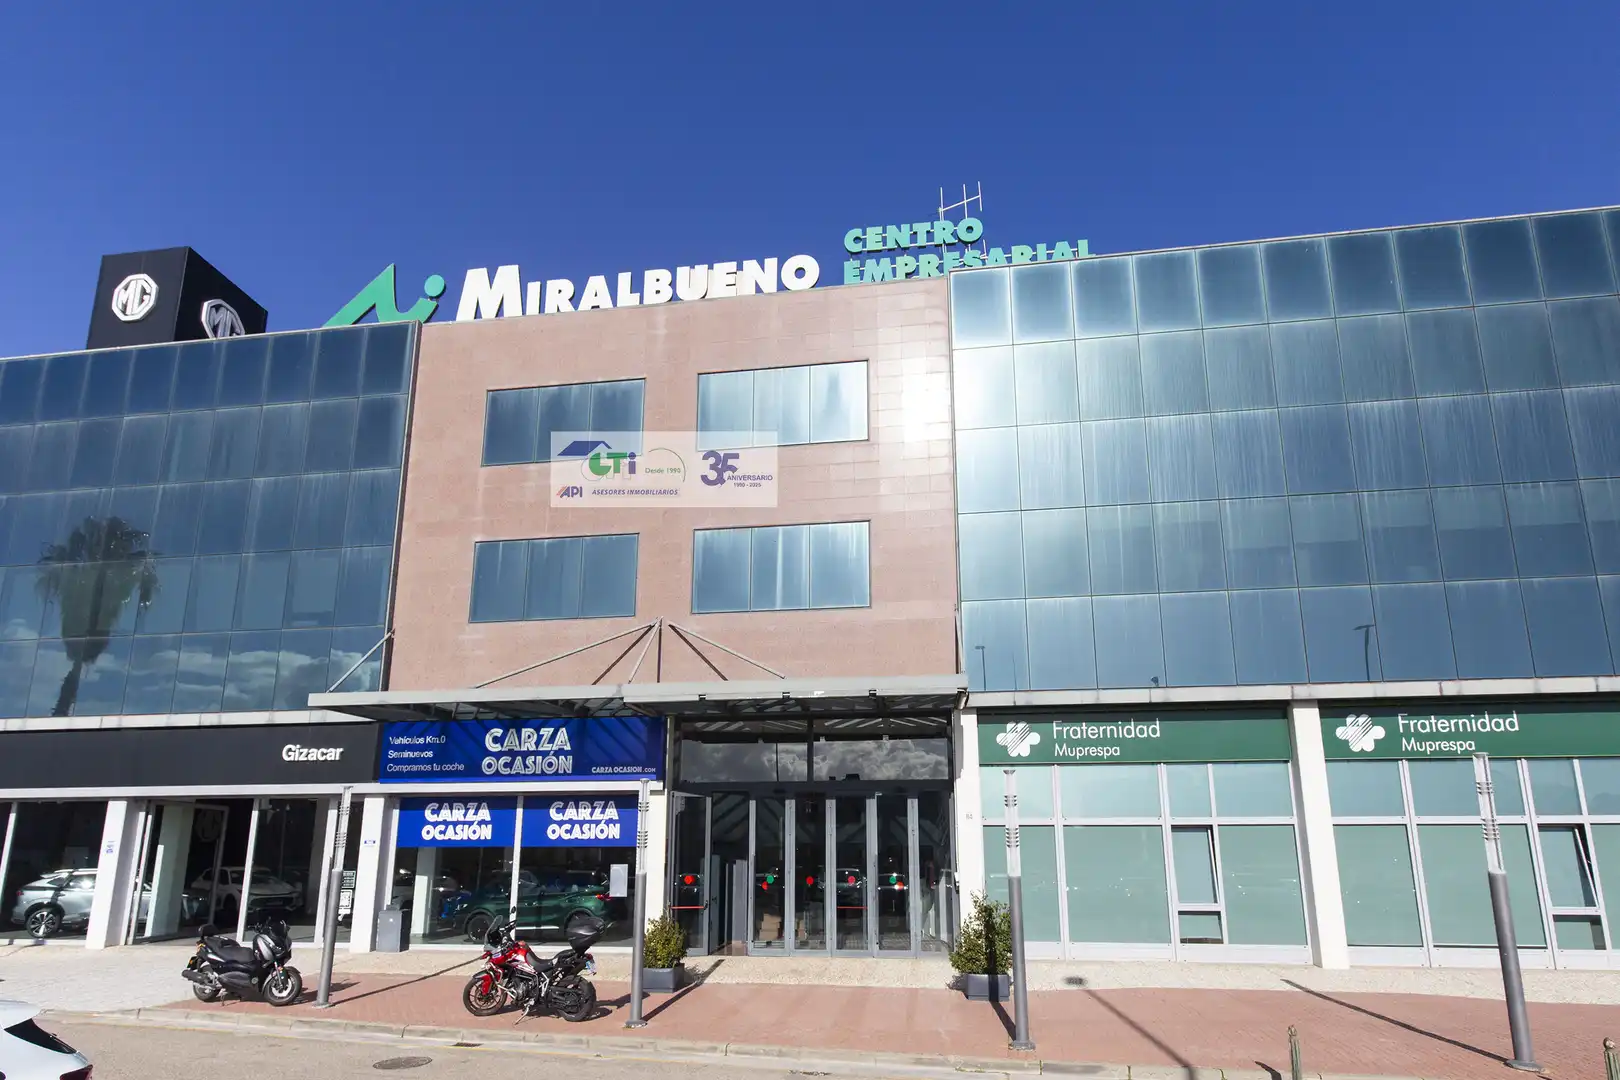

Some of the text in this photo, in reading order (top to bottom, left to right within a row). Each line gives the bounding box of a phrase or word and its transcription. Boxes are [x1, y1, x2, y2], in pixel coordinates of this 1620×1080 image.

[844, 217, 983, 252] CENTRO
[843, 239, 1096, 285] EMPRESARIAL
[116, 277, 152, 317] MG
[456, 254, 820, 322] MIRALBUENO
[1052, 718, 1161, 739] Fraternidad
[1398, 710, 1520, 733] Fraternidad
[389, 735, 446, 745] Vehículos Km.0
[485, 727, 571, 752] CARZA
[1402, 737, 1476, 754] Muprespa
[282, 744, 344, 762] Gizacar
[387, 750, 434, 759] Seminuevos
[1054, 743, 1121, 759] Muprespa
[386, 762, 465, 773] Compramos tu coche
[481, 751, 573, 775] OCASIÓN
[424, 802, 492, 822] CARZA
[549, 801, 619, 821] CARZA
[421, 820, 493, 840] OCASIÓN
[546, 820, 620, 840] OCASIÓN
